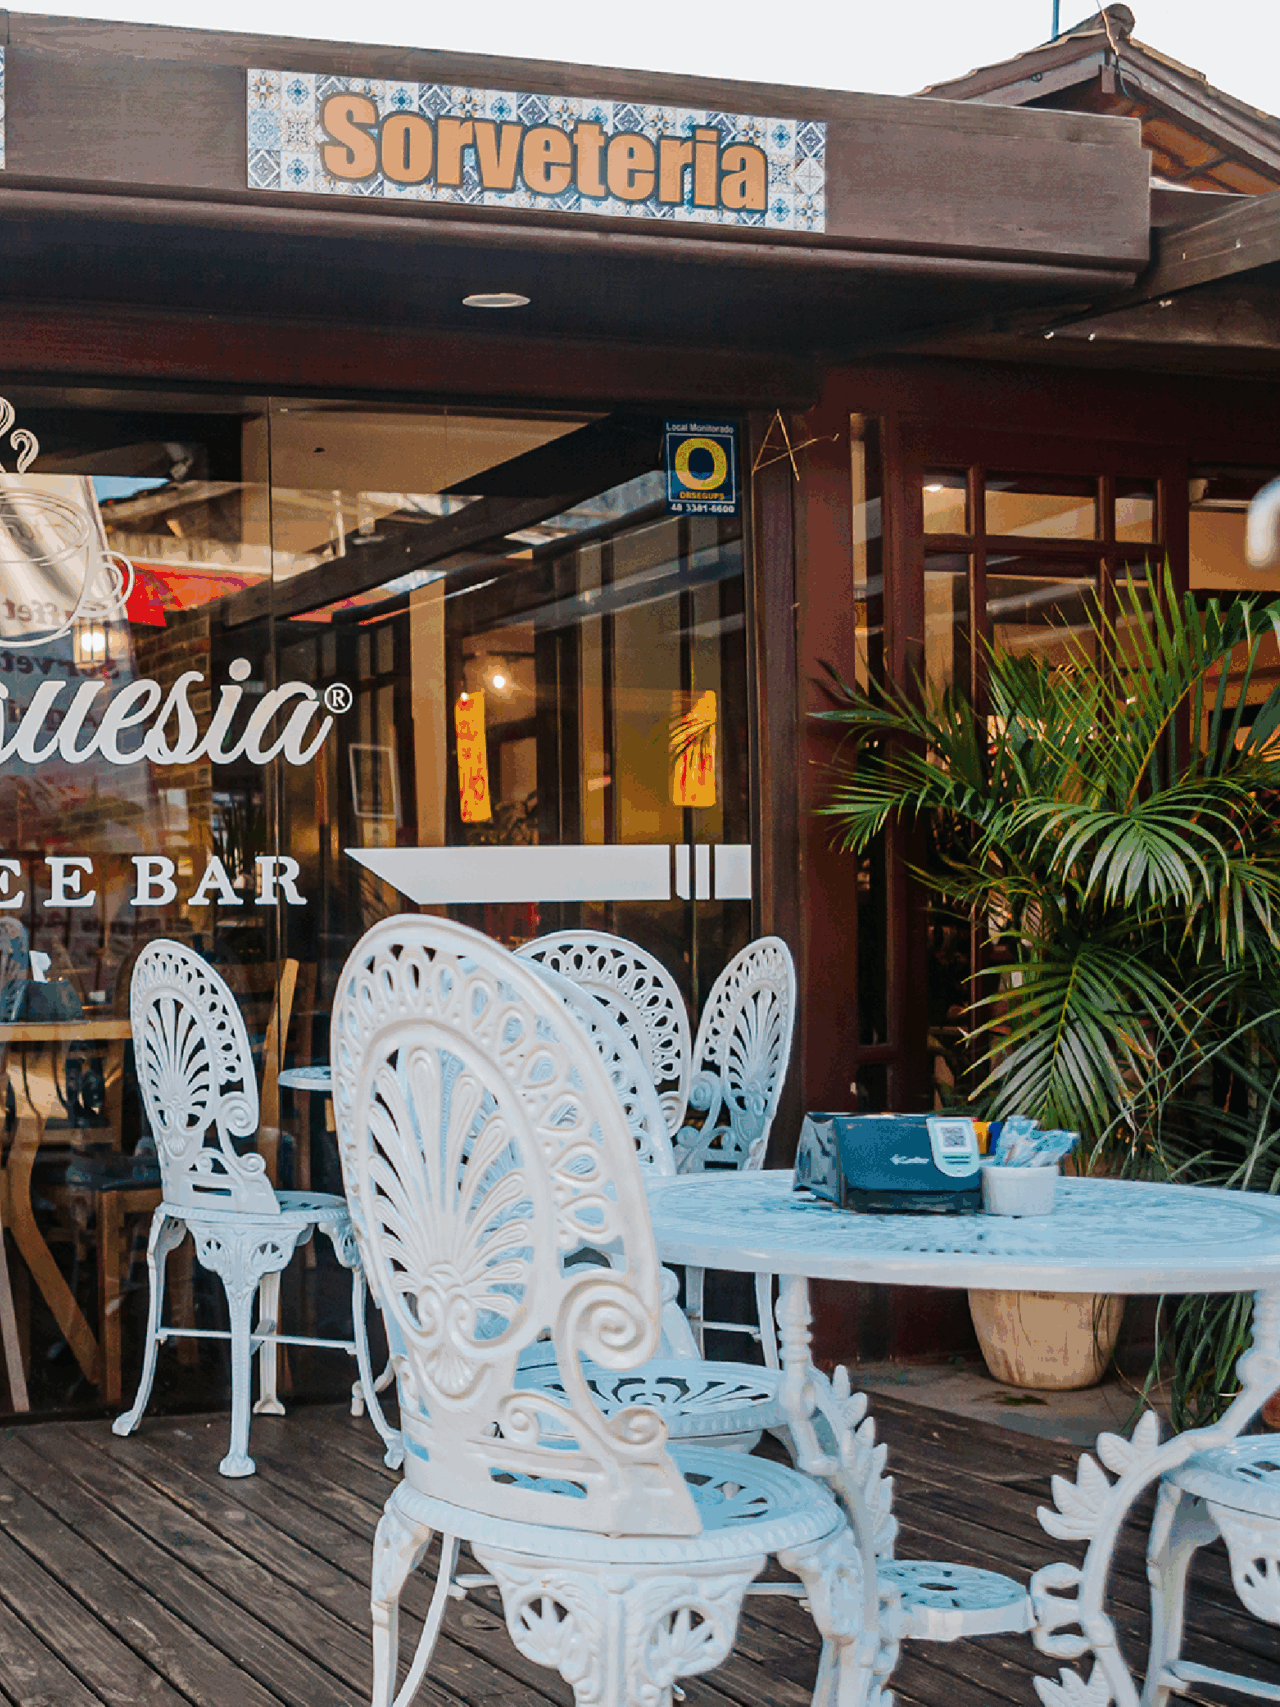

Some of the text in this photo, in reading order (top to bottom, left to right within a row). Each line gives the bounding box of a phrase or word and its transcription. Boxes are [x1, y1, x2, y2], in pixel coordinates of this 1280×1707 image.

[320, 91, 769, 214] Sorveteria
[666, 422, 734, 434] Local Monitorado
[129, 854, 307, 907] BAR
